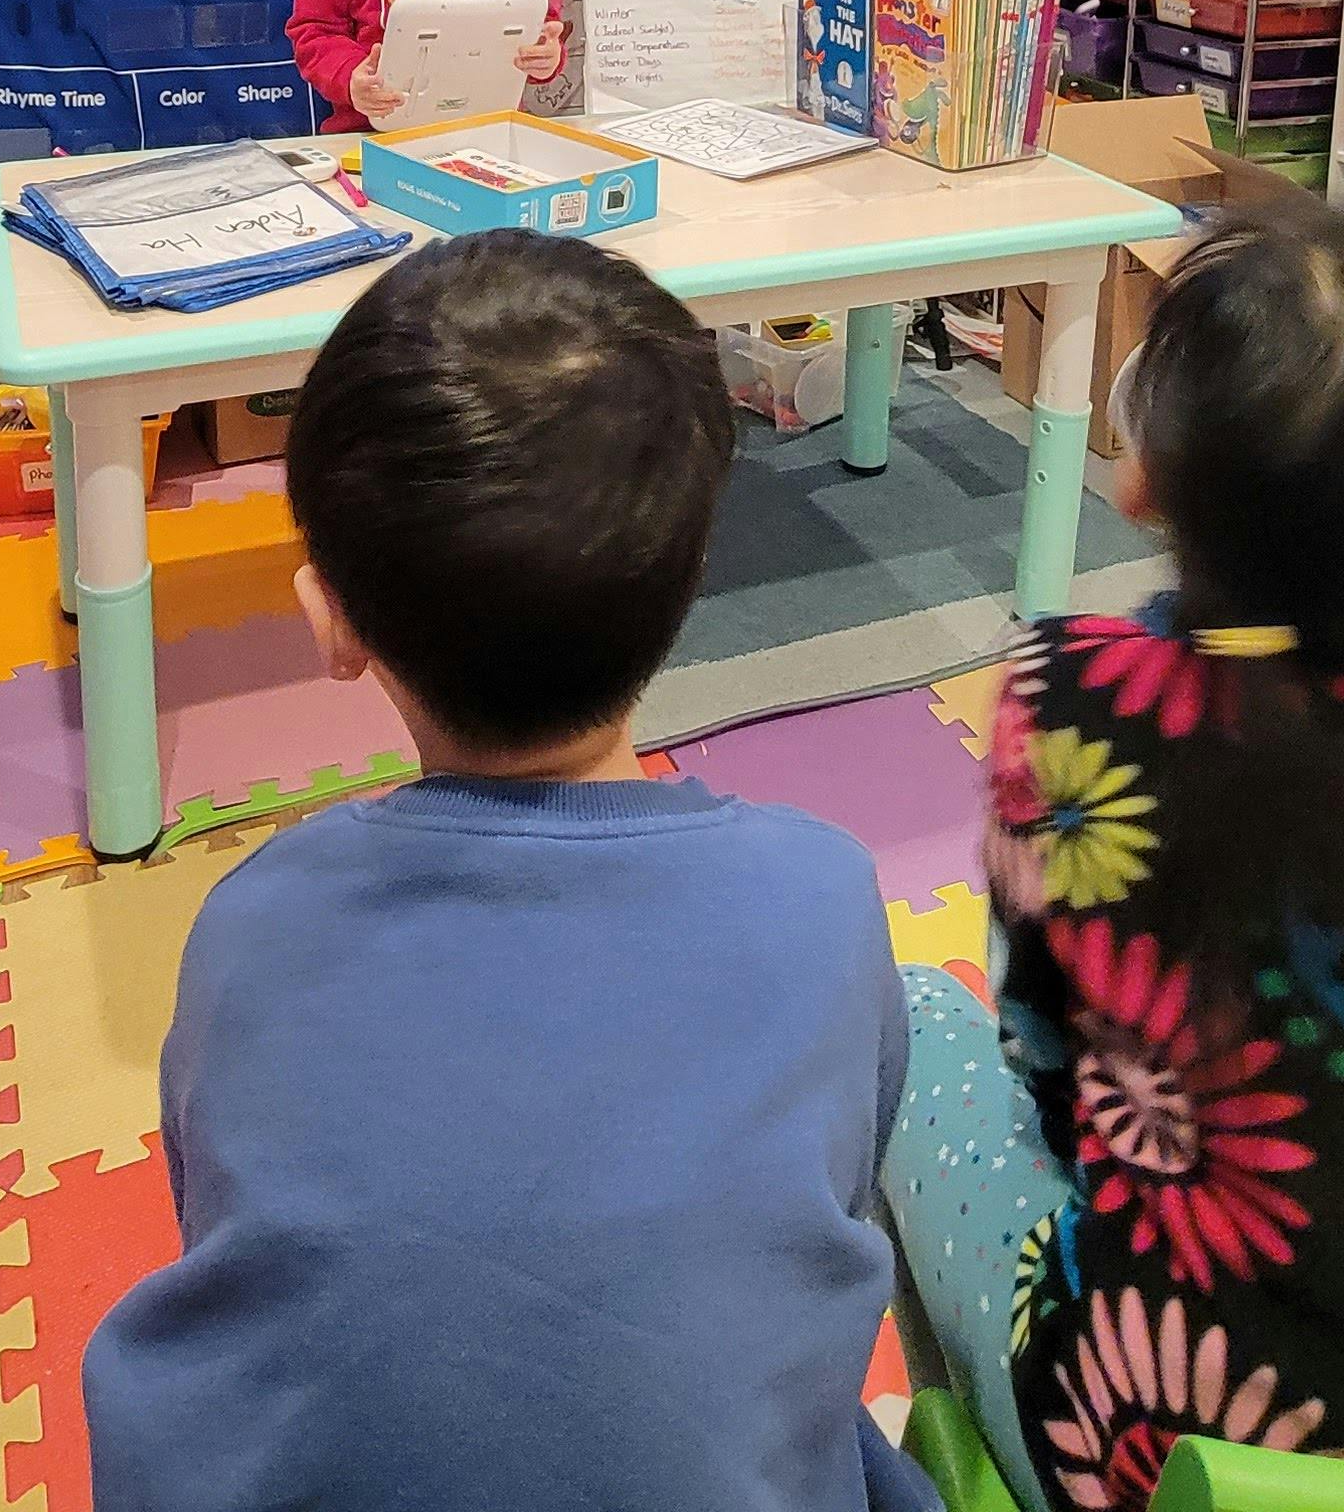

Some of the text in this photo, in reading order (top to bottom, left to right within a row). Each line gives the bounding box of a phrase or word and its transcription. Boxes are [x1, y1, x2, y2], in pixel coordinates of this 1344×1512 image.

[595, 9, 635, 19] Winter
[837, 6, 856, 23] THE
[830, 20, 863, 52] HAT
[638, 57, 661, 69] Days
[62, 91, 105, 106] Time
[159, 90, 205, 106] Color
[238, 85, 293, 104] Shape
[141, 204, 305, 252] Aiden Ha
